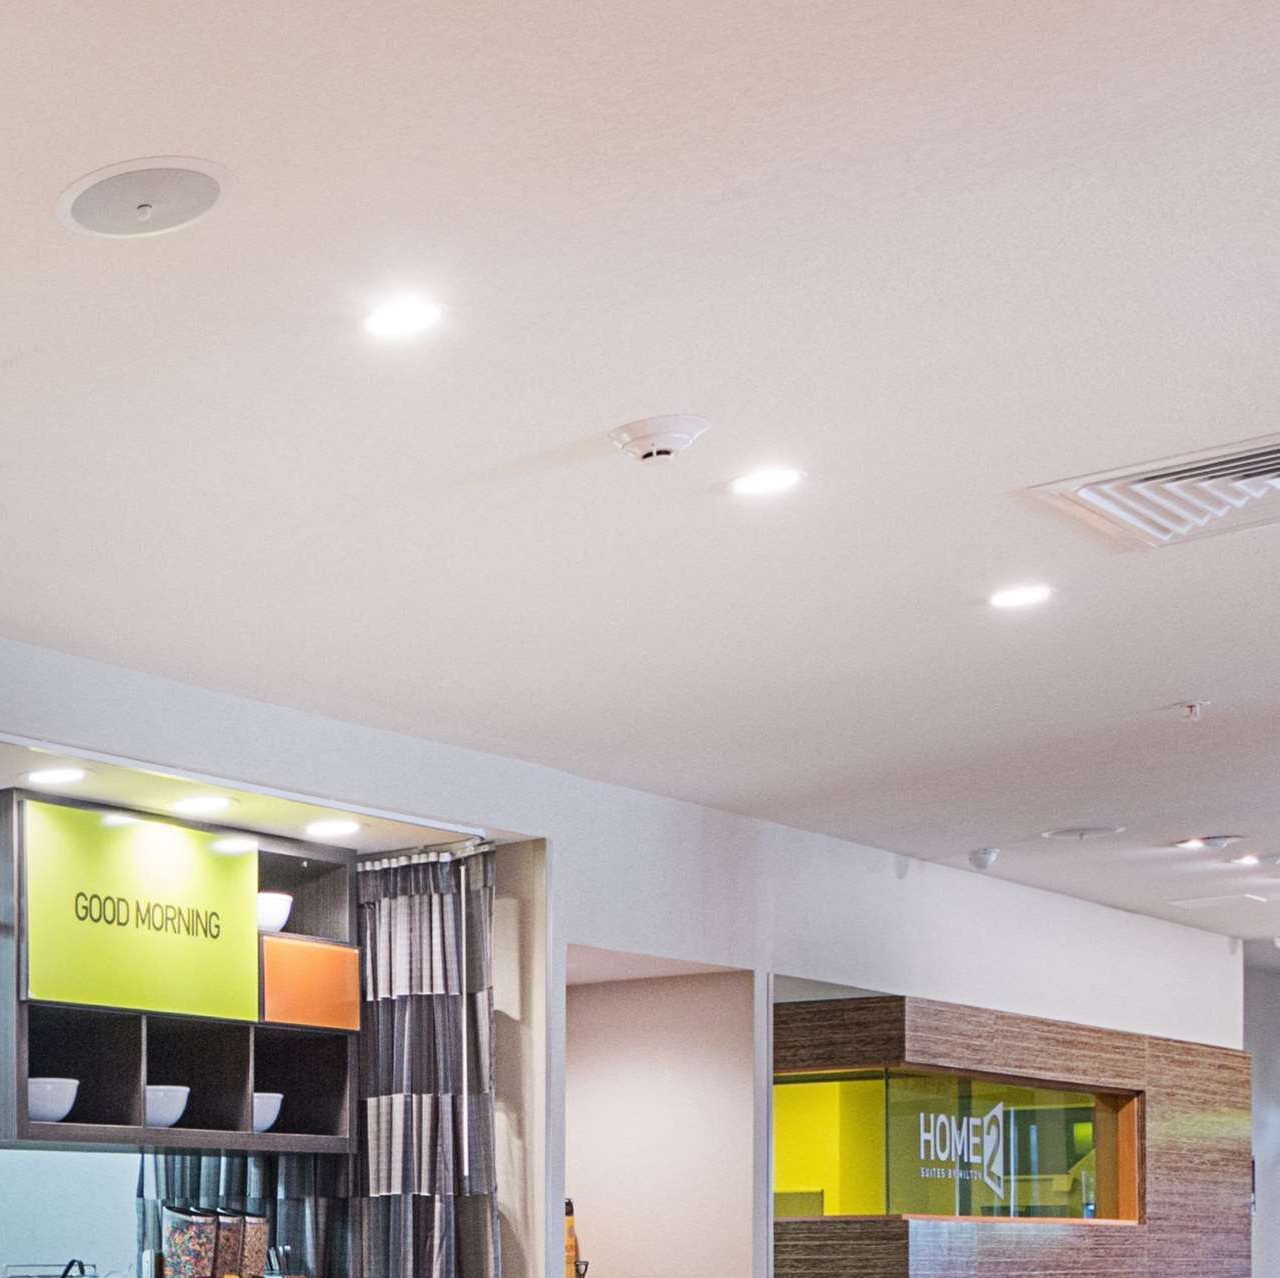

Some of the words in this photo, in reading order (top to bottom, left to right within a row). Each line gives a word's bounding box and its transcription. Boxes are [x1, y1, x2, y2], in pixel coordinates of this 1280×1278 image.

[74, 892, 130, 926] GOOD
[135, 901, 221, 939] MORNING
[921, 1167, 946, 1178] SUITES
